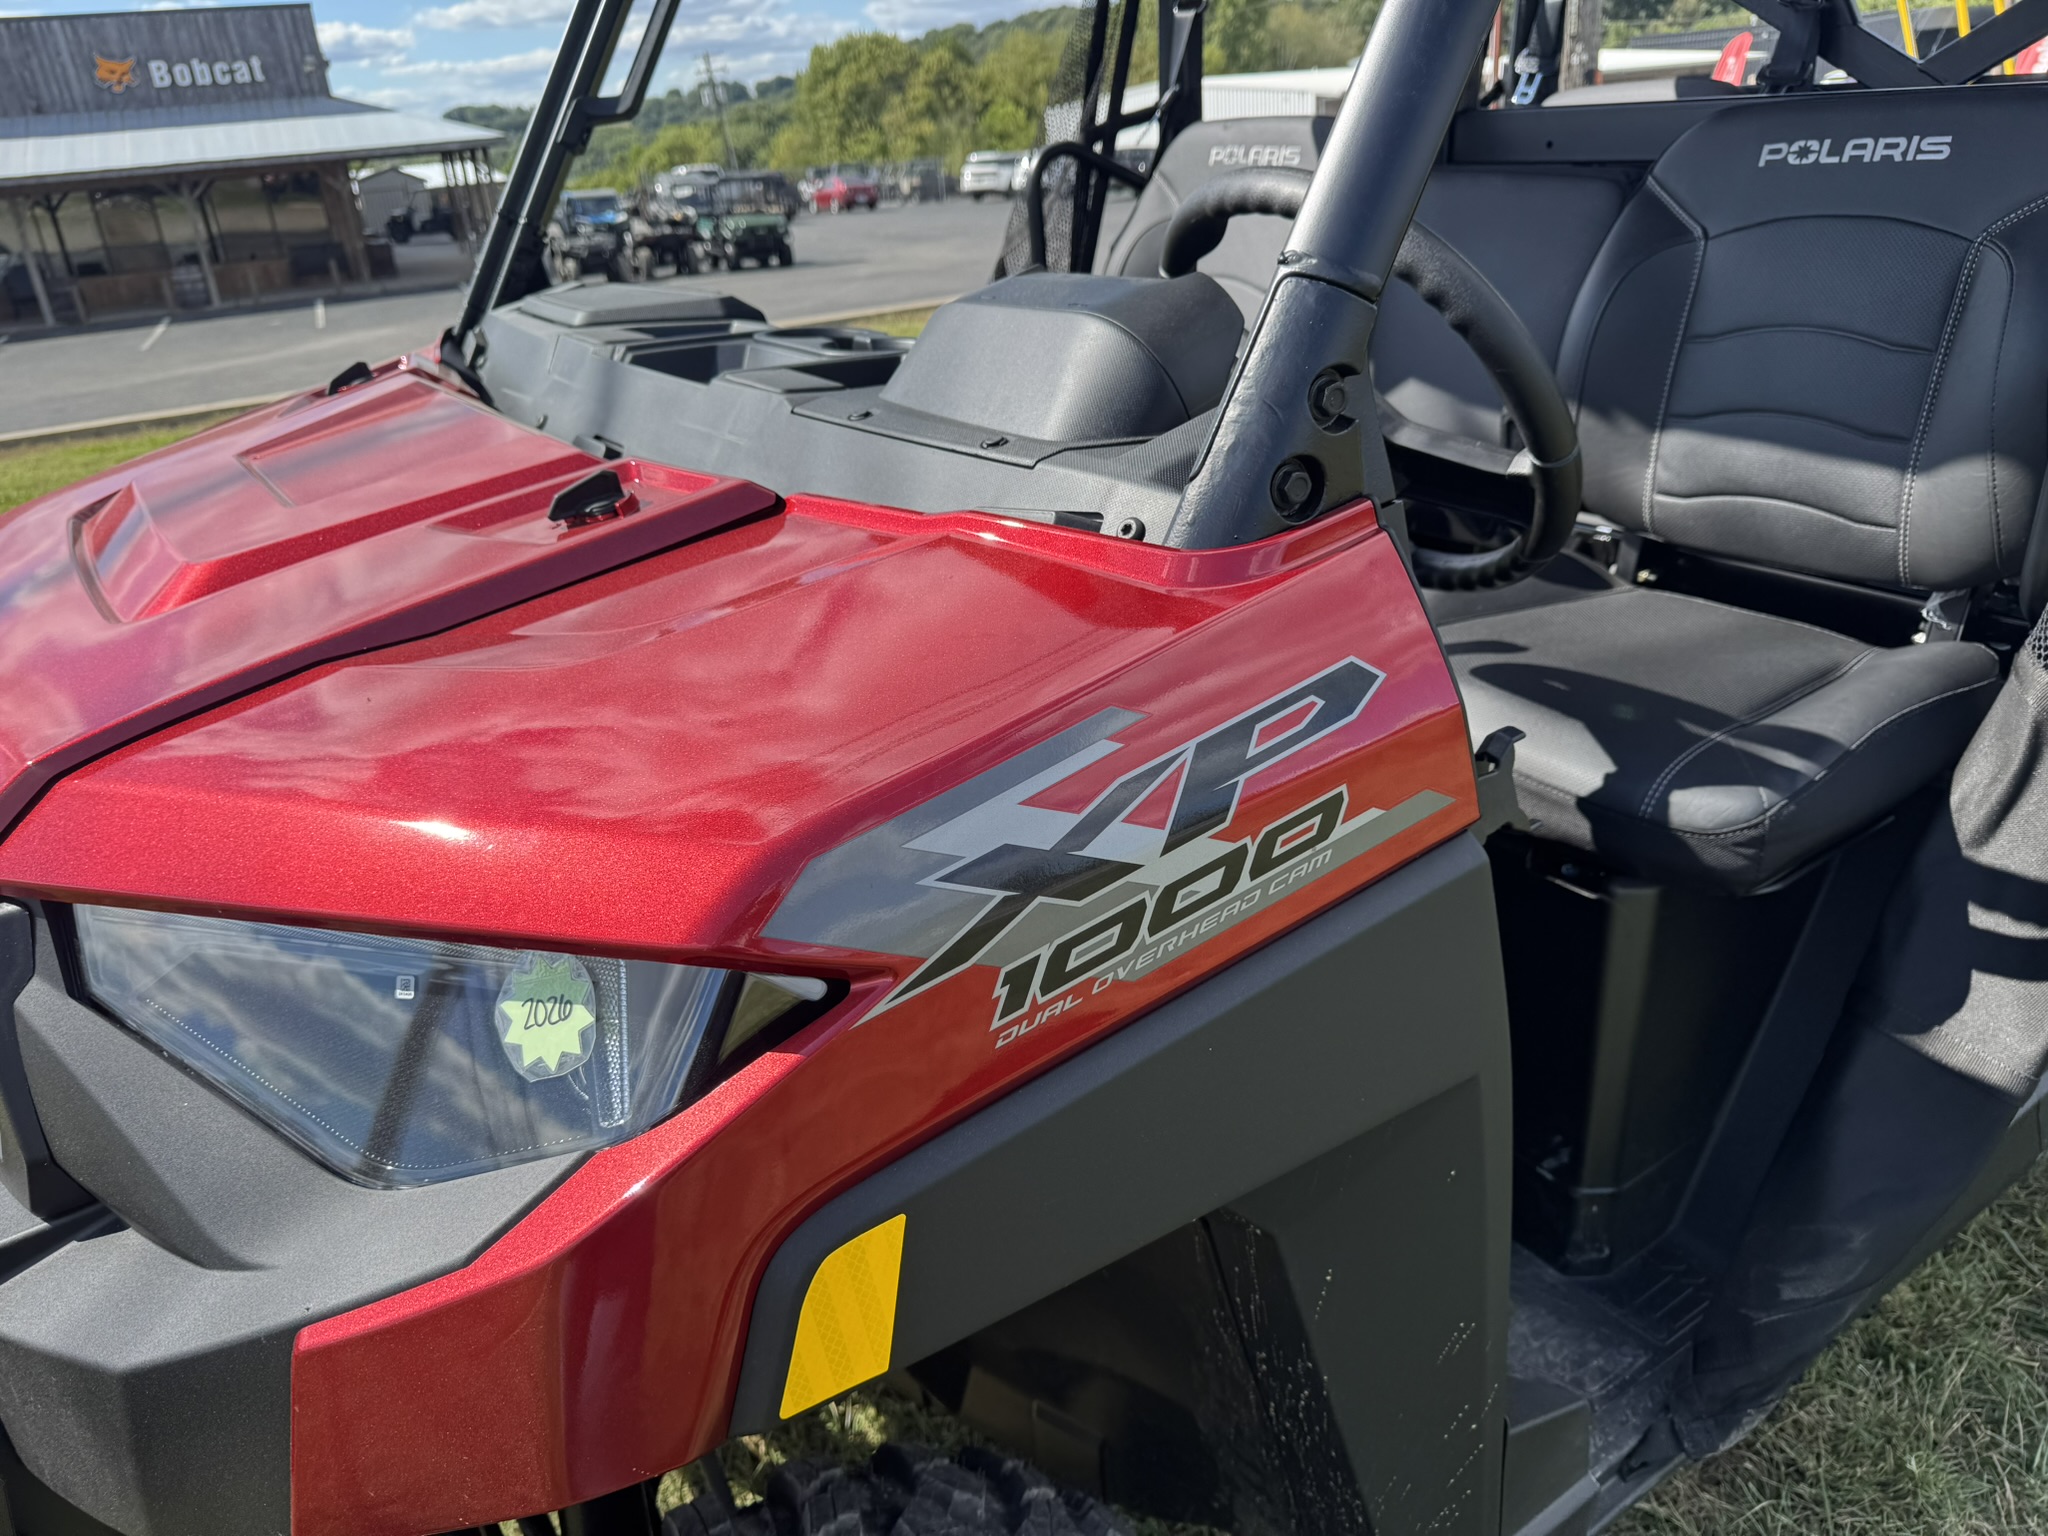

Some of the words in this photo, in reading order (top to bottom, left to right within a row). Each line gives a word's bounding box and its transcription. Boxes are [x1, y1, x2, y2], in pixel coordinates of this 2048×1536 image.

[148, 56, 266, 88] Bobcat
[1208, 144, 1302, 167] POLARIS
[1758, 135, 1953, 168] POLARIS
[850, 655, 1387, 1029] XP
[989, 783, 1349, 1032] 1000
[995, 996, 1083, 1049] DUAL
[1092, 888, 1261, 995] OVERHEAD
[1268, 848, 1332, 896] CAM
[521, 993, 573, 1030] 2026
